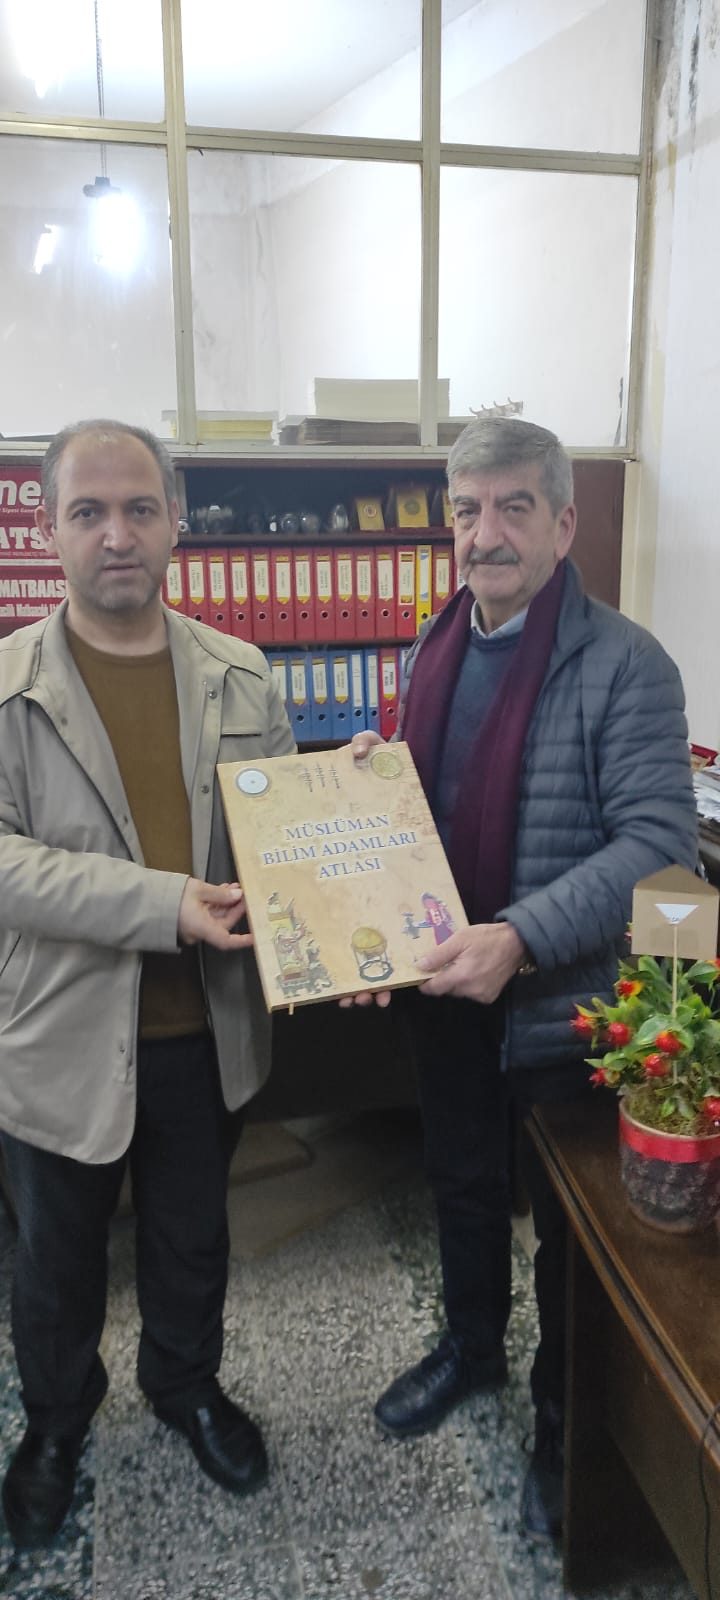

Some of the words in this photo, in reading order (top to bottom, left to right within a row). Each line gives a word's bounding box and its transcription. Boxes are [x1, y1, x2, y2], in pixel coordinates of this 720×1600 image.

[285, 814, 390, 841] MÜSLÜMAN
[263, 845, 317, 865] BİLİM
[321, 831, 419, 857] ADAMLARI
[319, 857, 382, 879] ATLASI
